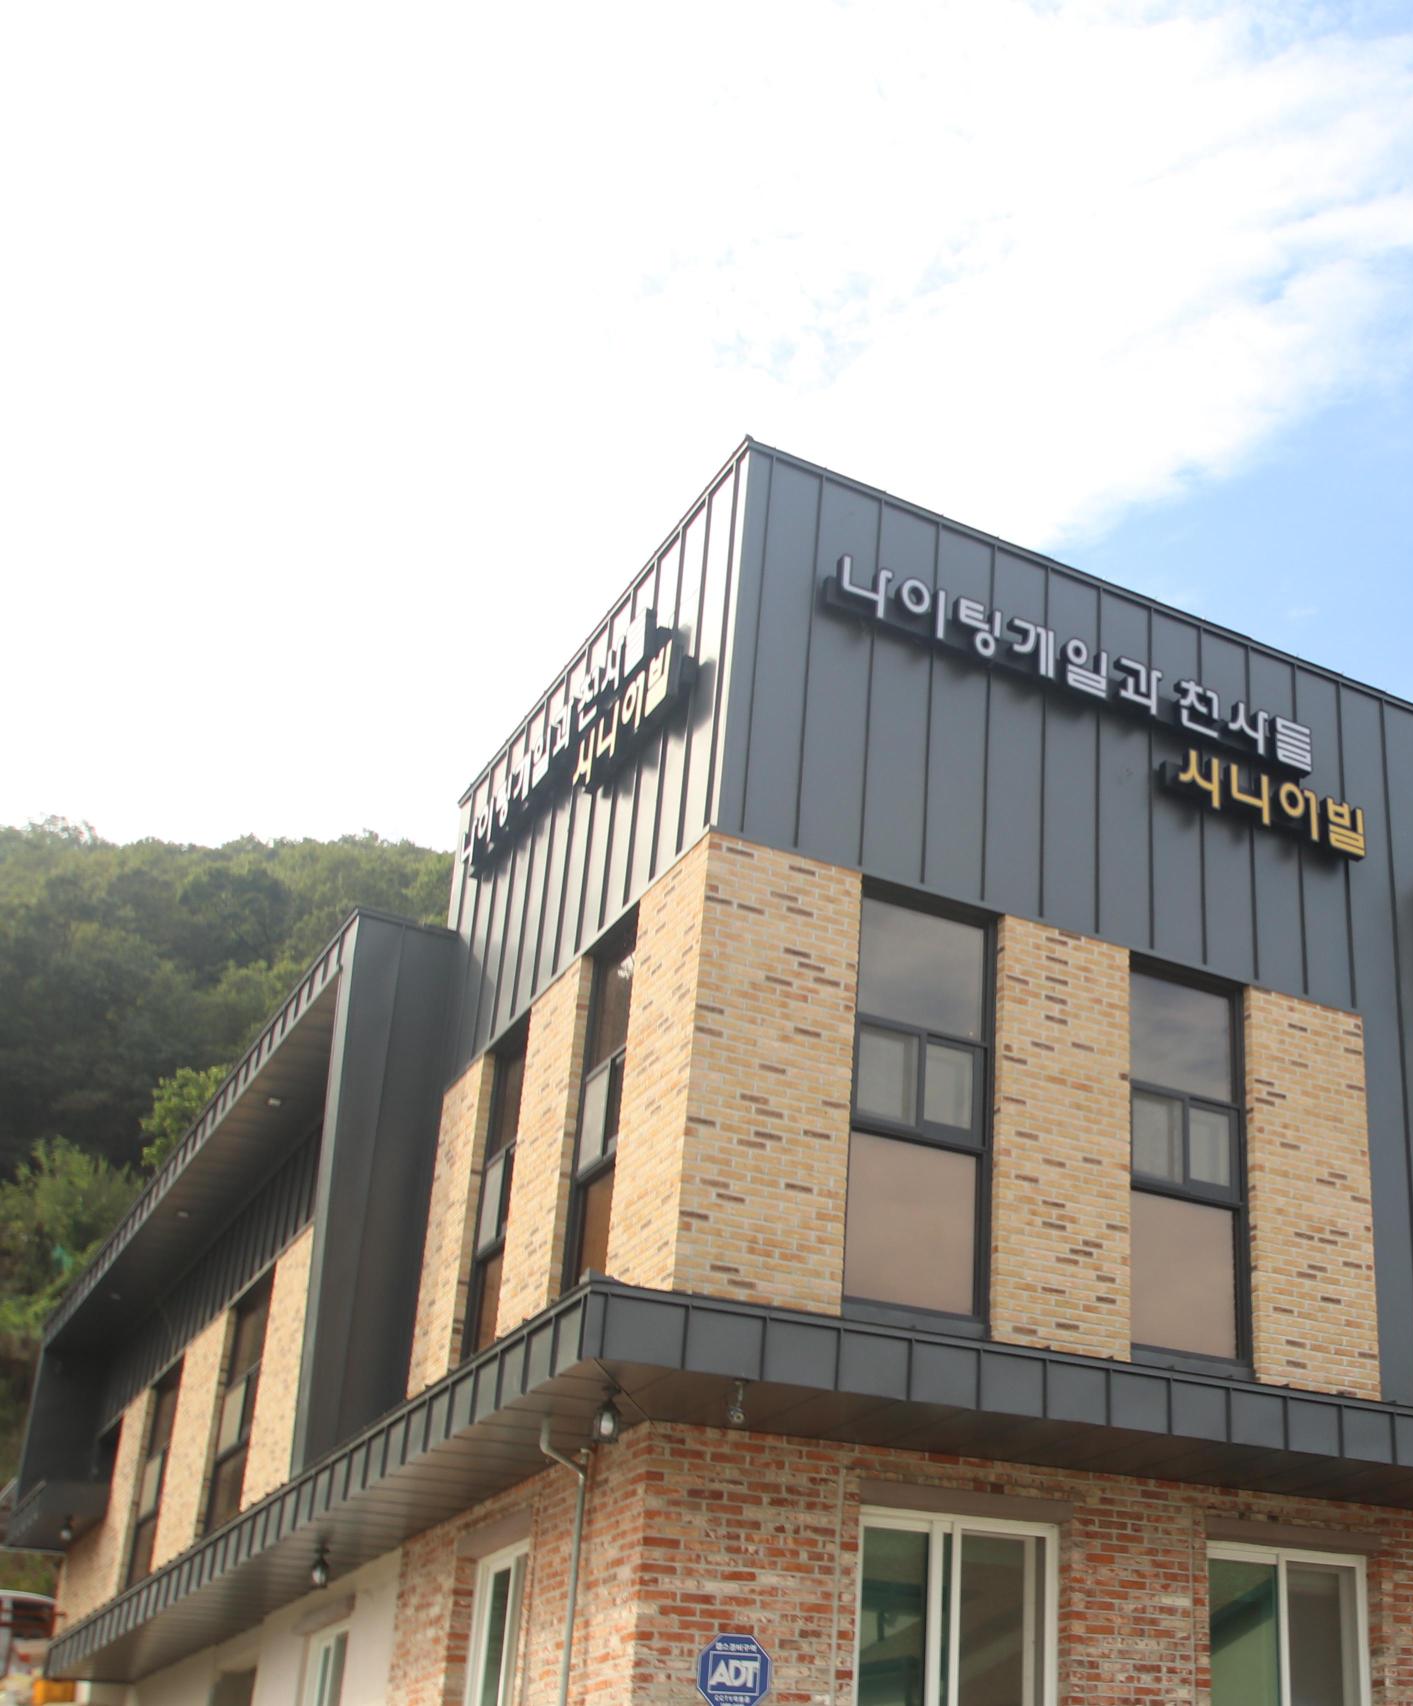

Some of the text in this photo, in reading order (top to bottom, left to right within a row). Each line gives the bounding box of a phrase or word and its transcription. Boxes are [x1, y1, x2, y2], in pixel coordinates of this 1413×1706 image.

[572, 639, 673, 787] 시니어빌
[839, 554, 1312, 778] 나이팅게일과 천사들
[1178, 749, 1366, 861] 시니어빌
[708, 1659, 760, 1688] ADT
